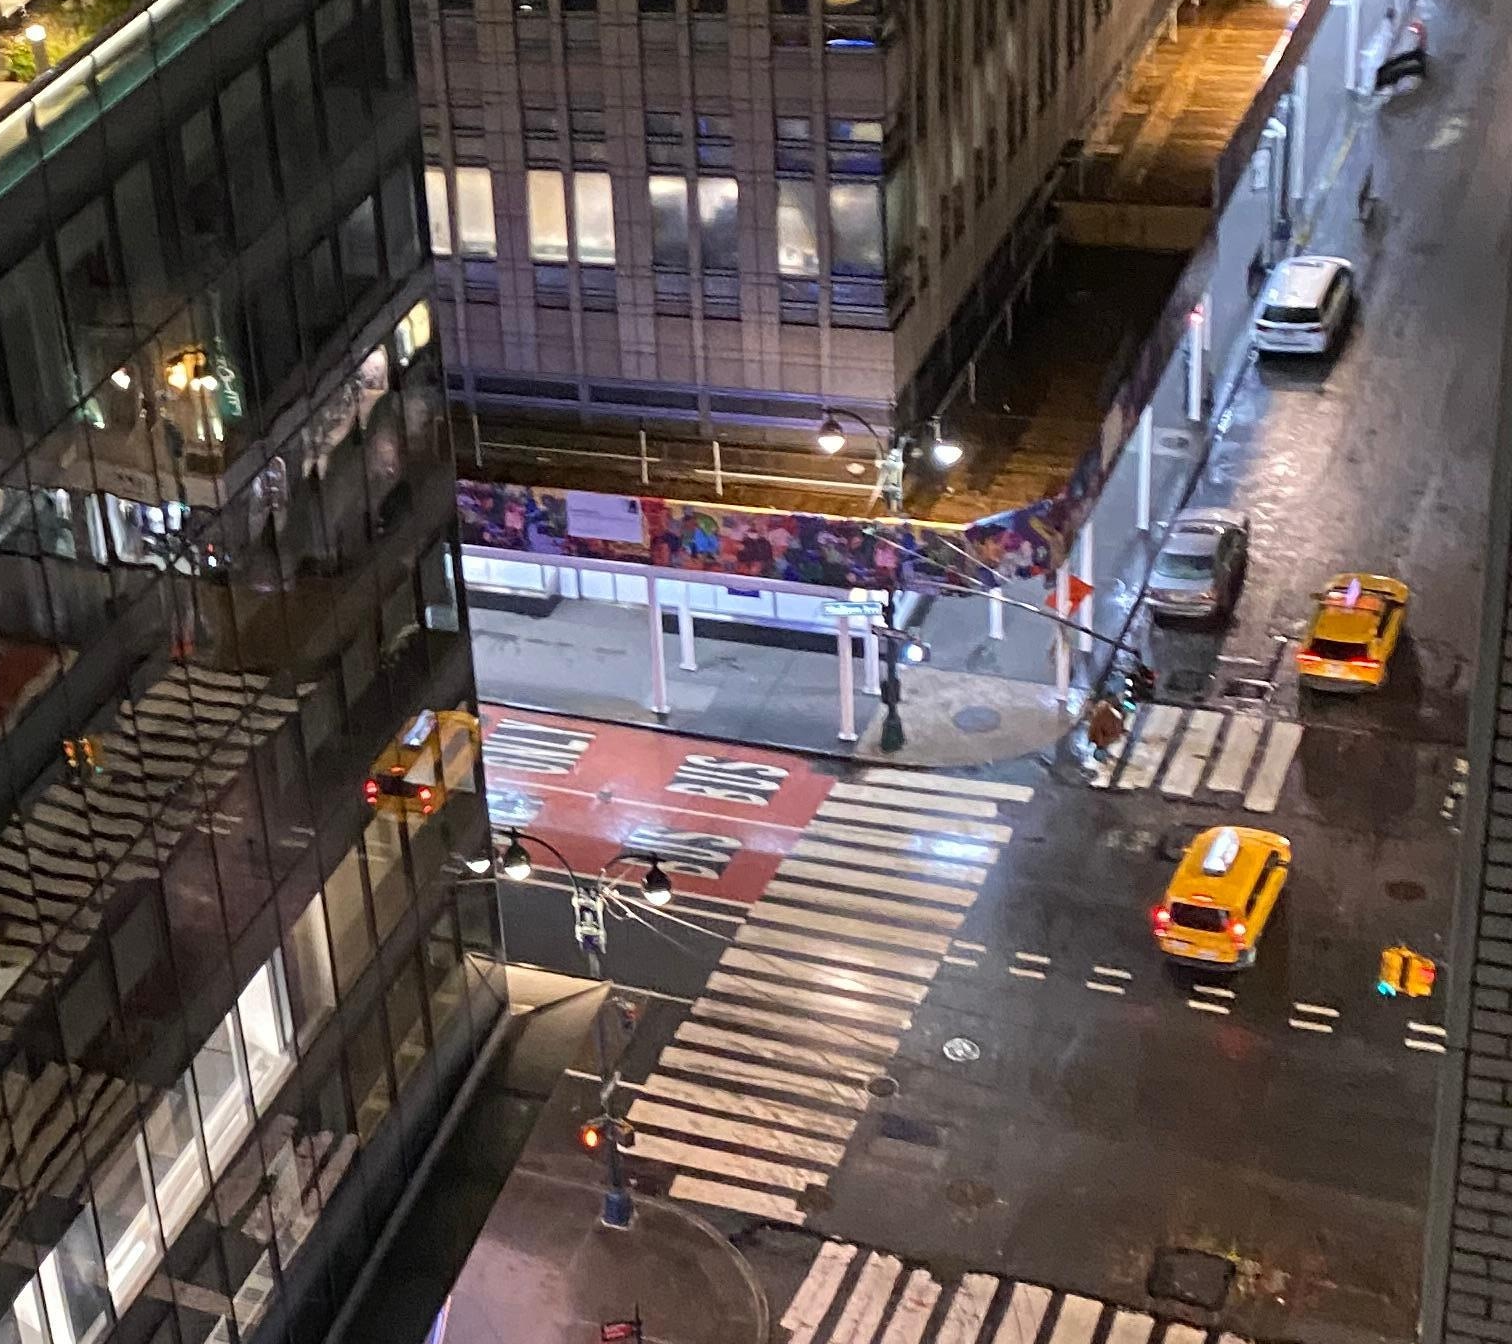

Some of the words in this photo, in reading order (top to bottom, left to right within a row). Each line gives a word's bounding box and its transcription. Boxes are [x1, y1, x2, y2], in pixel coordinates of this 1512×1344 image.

[482, 718, 597, 774] ONLY
[664, 754, 790, 806] BUS
[619, 825, 743, 880] BUS
